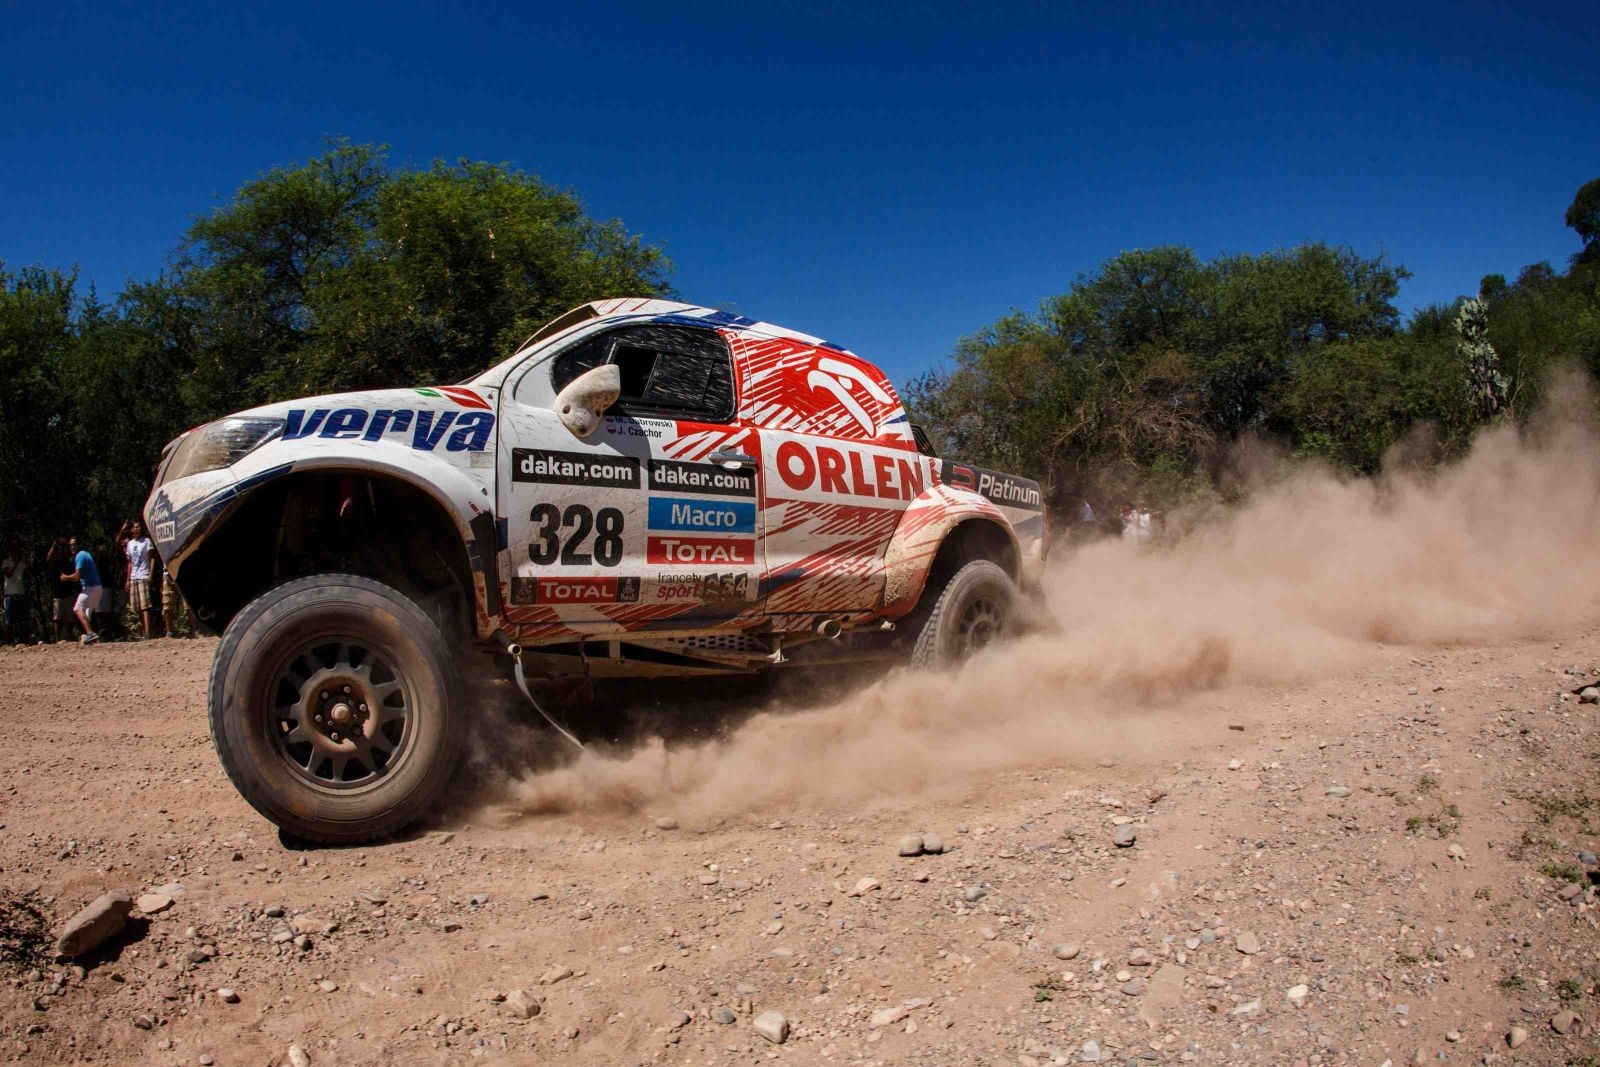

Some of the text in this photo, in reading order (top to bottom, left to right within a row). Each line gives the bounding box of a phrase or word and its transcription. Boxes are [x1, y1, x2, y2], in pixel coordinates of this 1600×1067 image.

[281, 408, 496, 452] verva
[628, 427, 663, 438] Czachor
[520, 455, 633, 481] dakar.com
[654, 465, 750, 490] dakar.com
[776, 440, 924, 501] ORLEN
[977, 473, 1040, 506] Platinum
[671, 504, 737, 528] Macro
[528, 502, 625, 568] 328
[660, 539, 745, 562] TOTAL
[540, 581, 614, 599] TOTAL
[656, 583, 701, 601] sport
